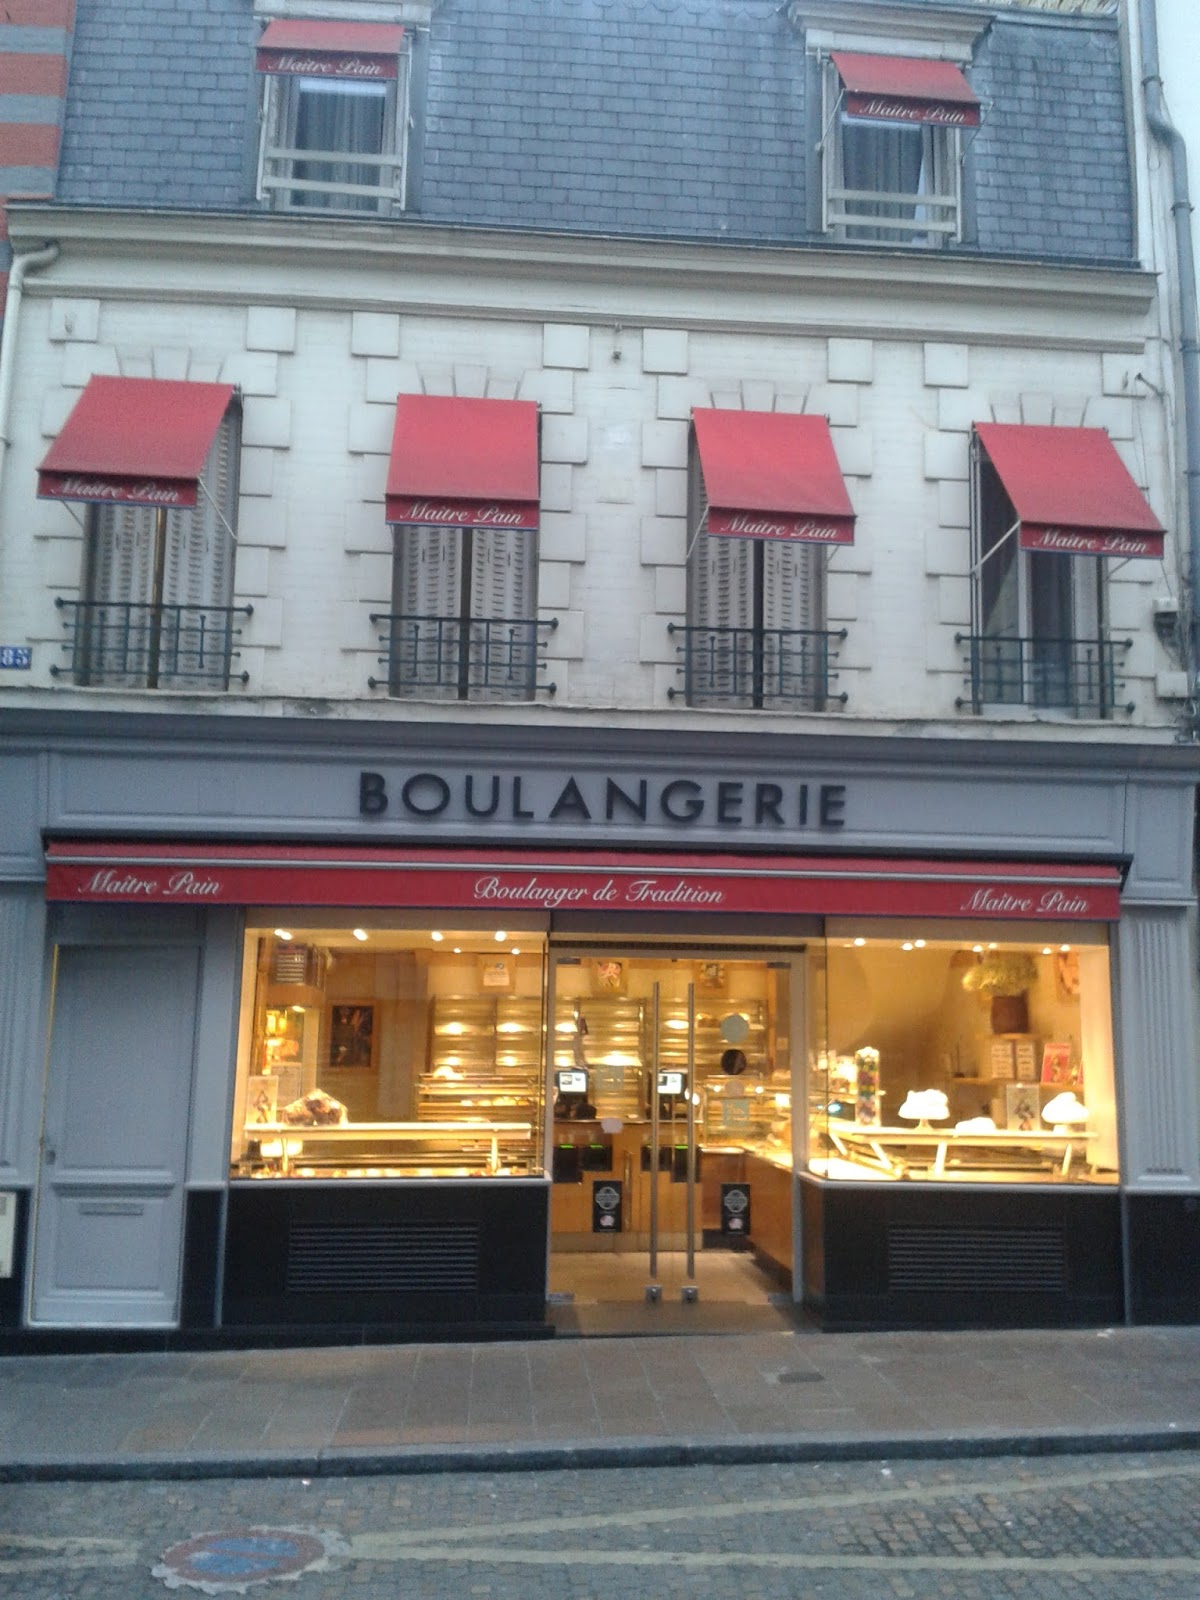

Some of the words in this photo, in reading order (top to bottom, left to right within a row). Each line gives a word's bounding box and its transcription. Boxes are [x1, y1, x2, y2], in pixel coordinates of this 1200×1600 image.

[922, 106, 965, 123] Pain
[472, 507, 524, 524] Pain
[789, 521, 838, 539] Pain
[1101, 534, 1147, 553] Pain
[359, 772, 847, 827] BOULANGERIE
[77, 868, 159, 894] Maître
[162, 871, 223, 896] Pain
[473, 876, 589, 908] Boulanger
[592, 879, 618, 901] de
[625, 880, 725, 904] Tradition
[960, 888, 1033, 912] Maître
[1035, 890, 1091, 914] Pain
